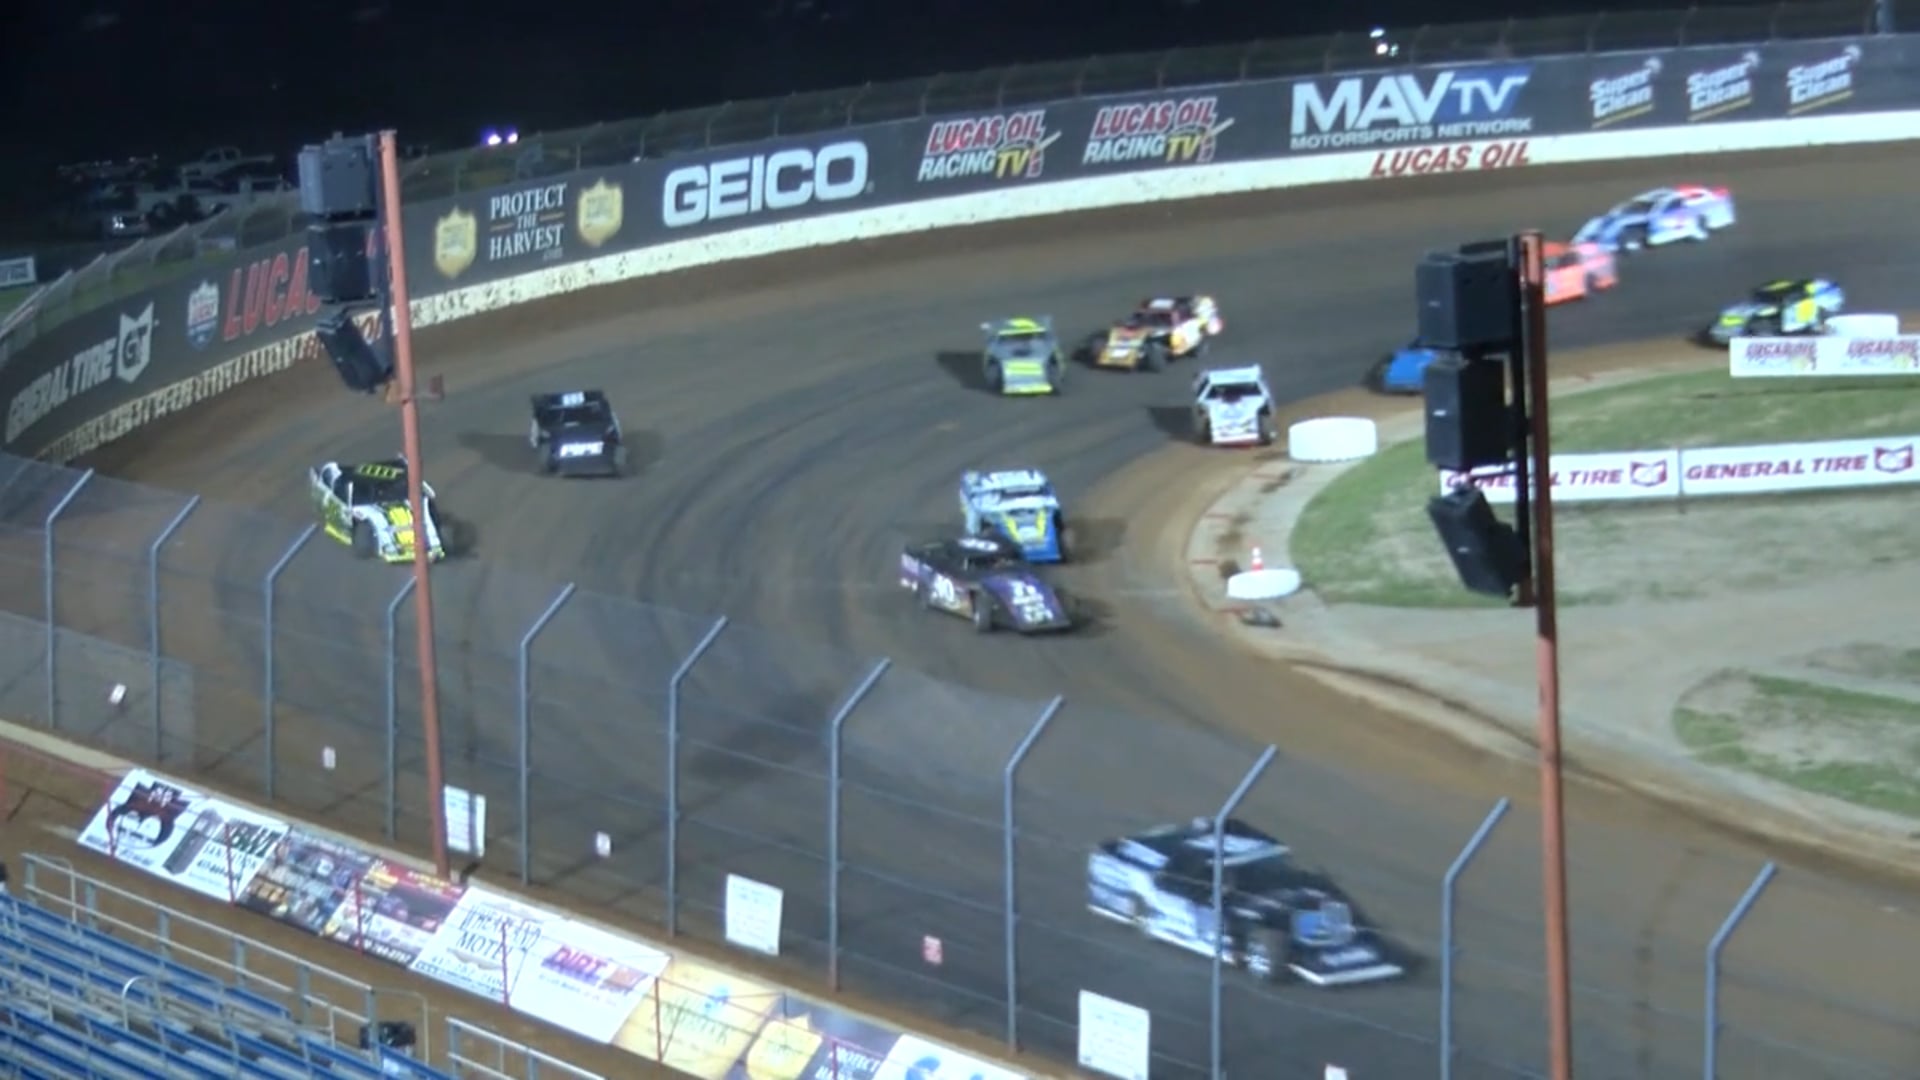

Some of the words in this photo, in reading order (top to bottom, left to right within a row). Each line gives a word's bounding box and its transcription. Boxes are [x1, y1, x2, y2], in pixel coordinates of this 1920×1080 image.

[1590, 69, 1651, 100] Super
[1687, 62, 1750, 94] Super
[1787, 55, 1850, 87] Super
[1593, 86, 1653, 118] Clean
[1690, 80, 1750, 111] Clean
[1791, 73, 1851, 104] Clean
[925, 115, 1001, 155] LUCAS
[1005, 109, 1046, 142] OIL
[1089, 99, 1171, 140] LUCAS
[1174, 97, 1218, 130] OIL
[1290, 124, 1433, 149] MOTORSPORTS
[1438, 117, 1532, 138] NETWORK
[917, 149, 996, 182] RACING
[995, 148, 1032, 179] TV
[1082, 134, 1166, 164] RACING
[1166, 134, 1204, 163] TV
[1370, 145, 1472, 177] LUCAS
[1480, 141, 1529, 170] OIL
[490, 181, 567, 220] PROTECT
[662, 140, 869, 229] GEICO
[517, 211, 537, 230] THE
[489, 222, 565, 261] HARVEST
[5, 362, 69, 443] GENERAL
[71, 336, 119, 396] TIRE
[1569, 468, 1624, 486] TIRE
[1686, 459, 1805, 480] GENERAL
[1811, 454, 1868, 473] TIRE
[553, 943, 608, 974] DIRT
